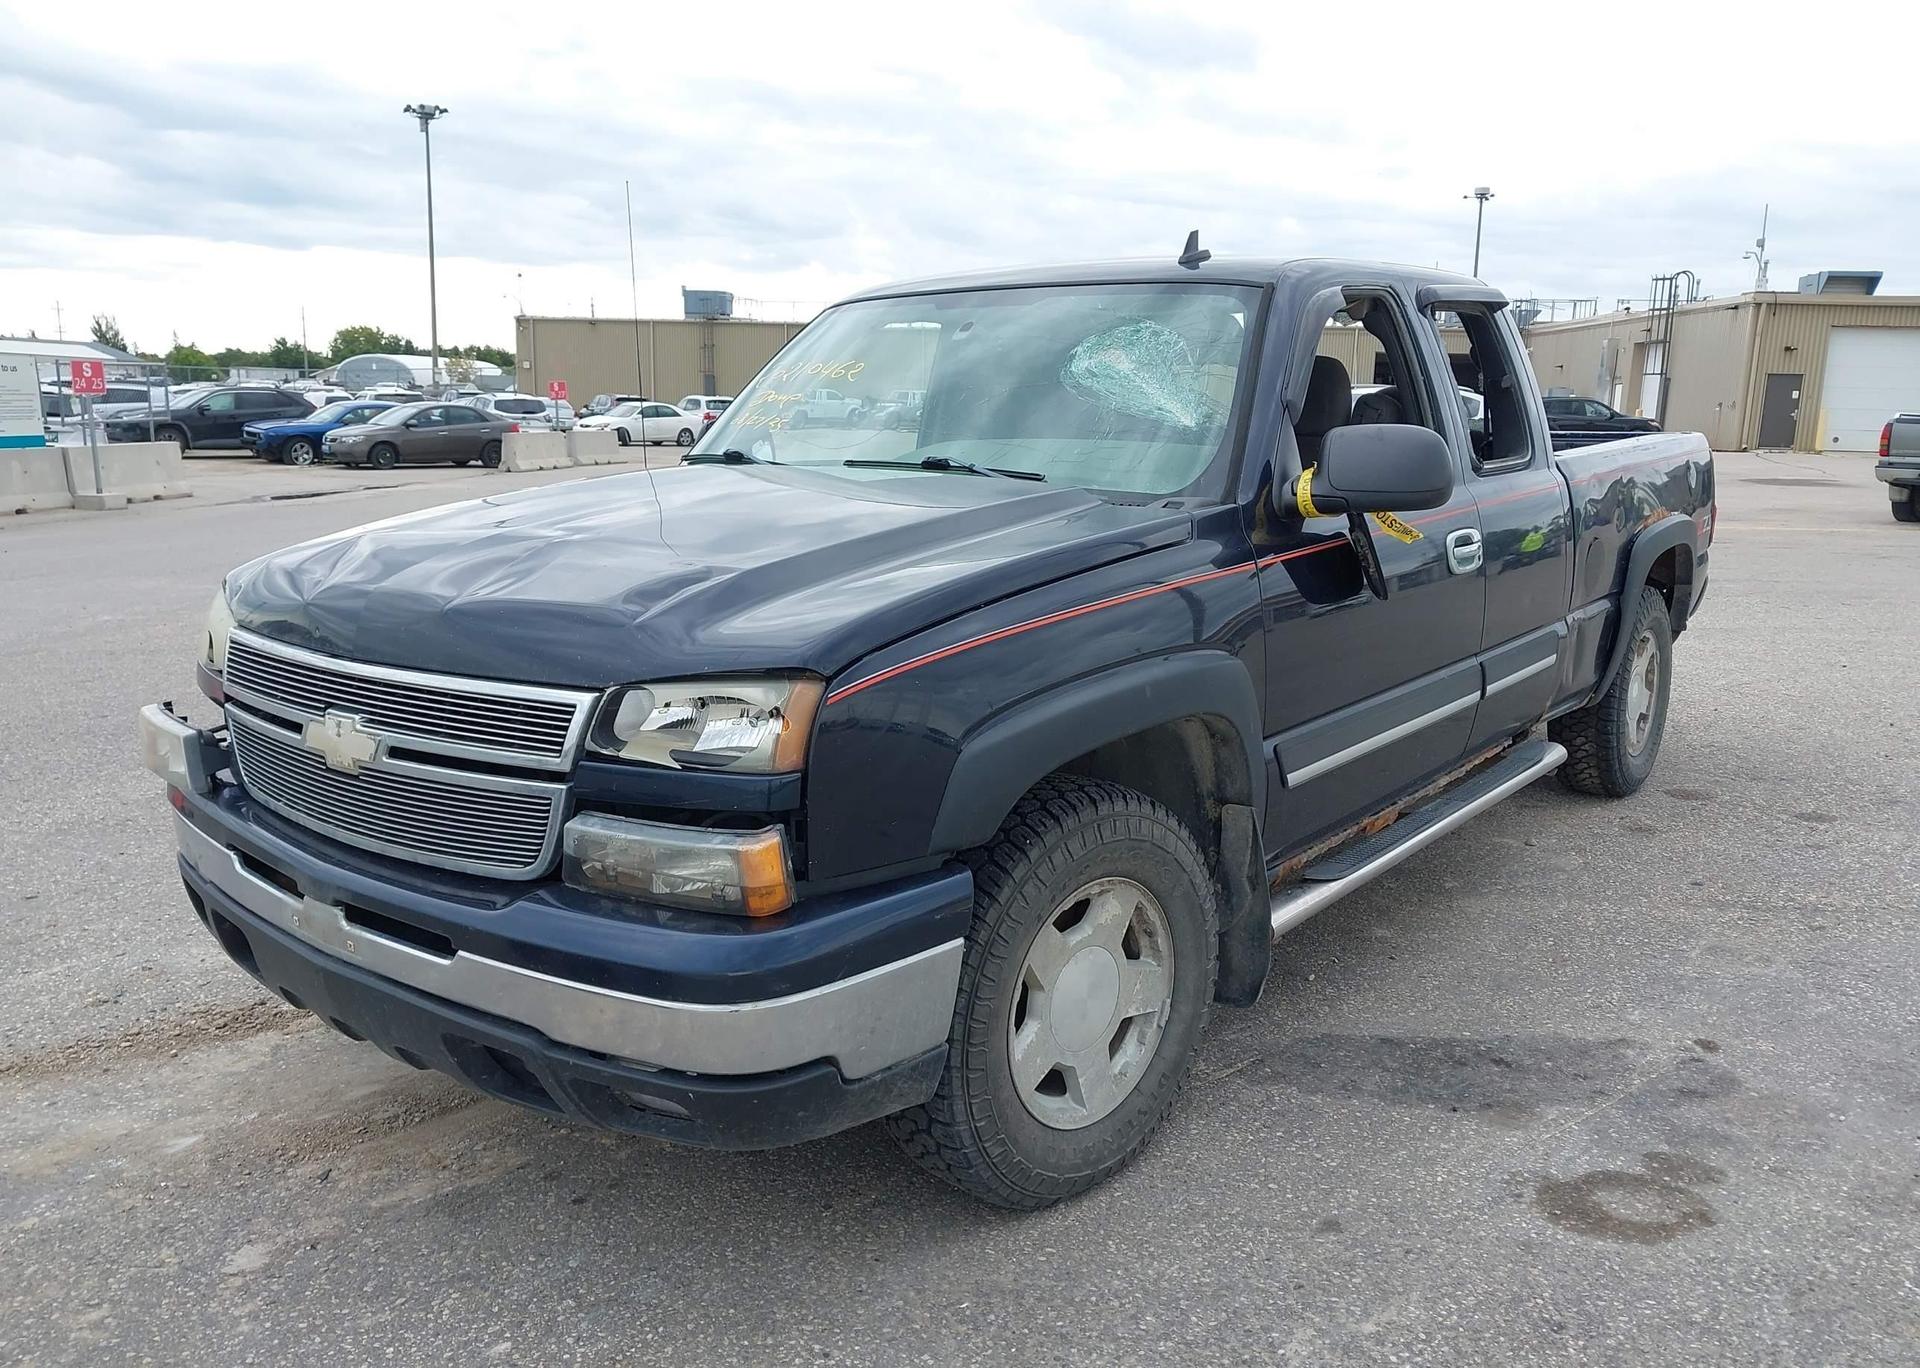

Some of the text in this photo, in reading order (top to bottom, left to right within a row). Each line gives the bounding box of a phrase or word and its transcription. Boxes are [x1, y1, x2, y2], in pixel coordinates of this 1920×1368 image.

[9, 365, 18, 373] us
[82, 362, 92, 378] S
[74, 377, 103, 390] 24 25
[553, 382, 559, 391] S
